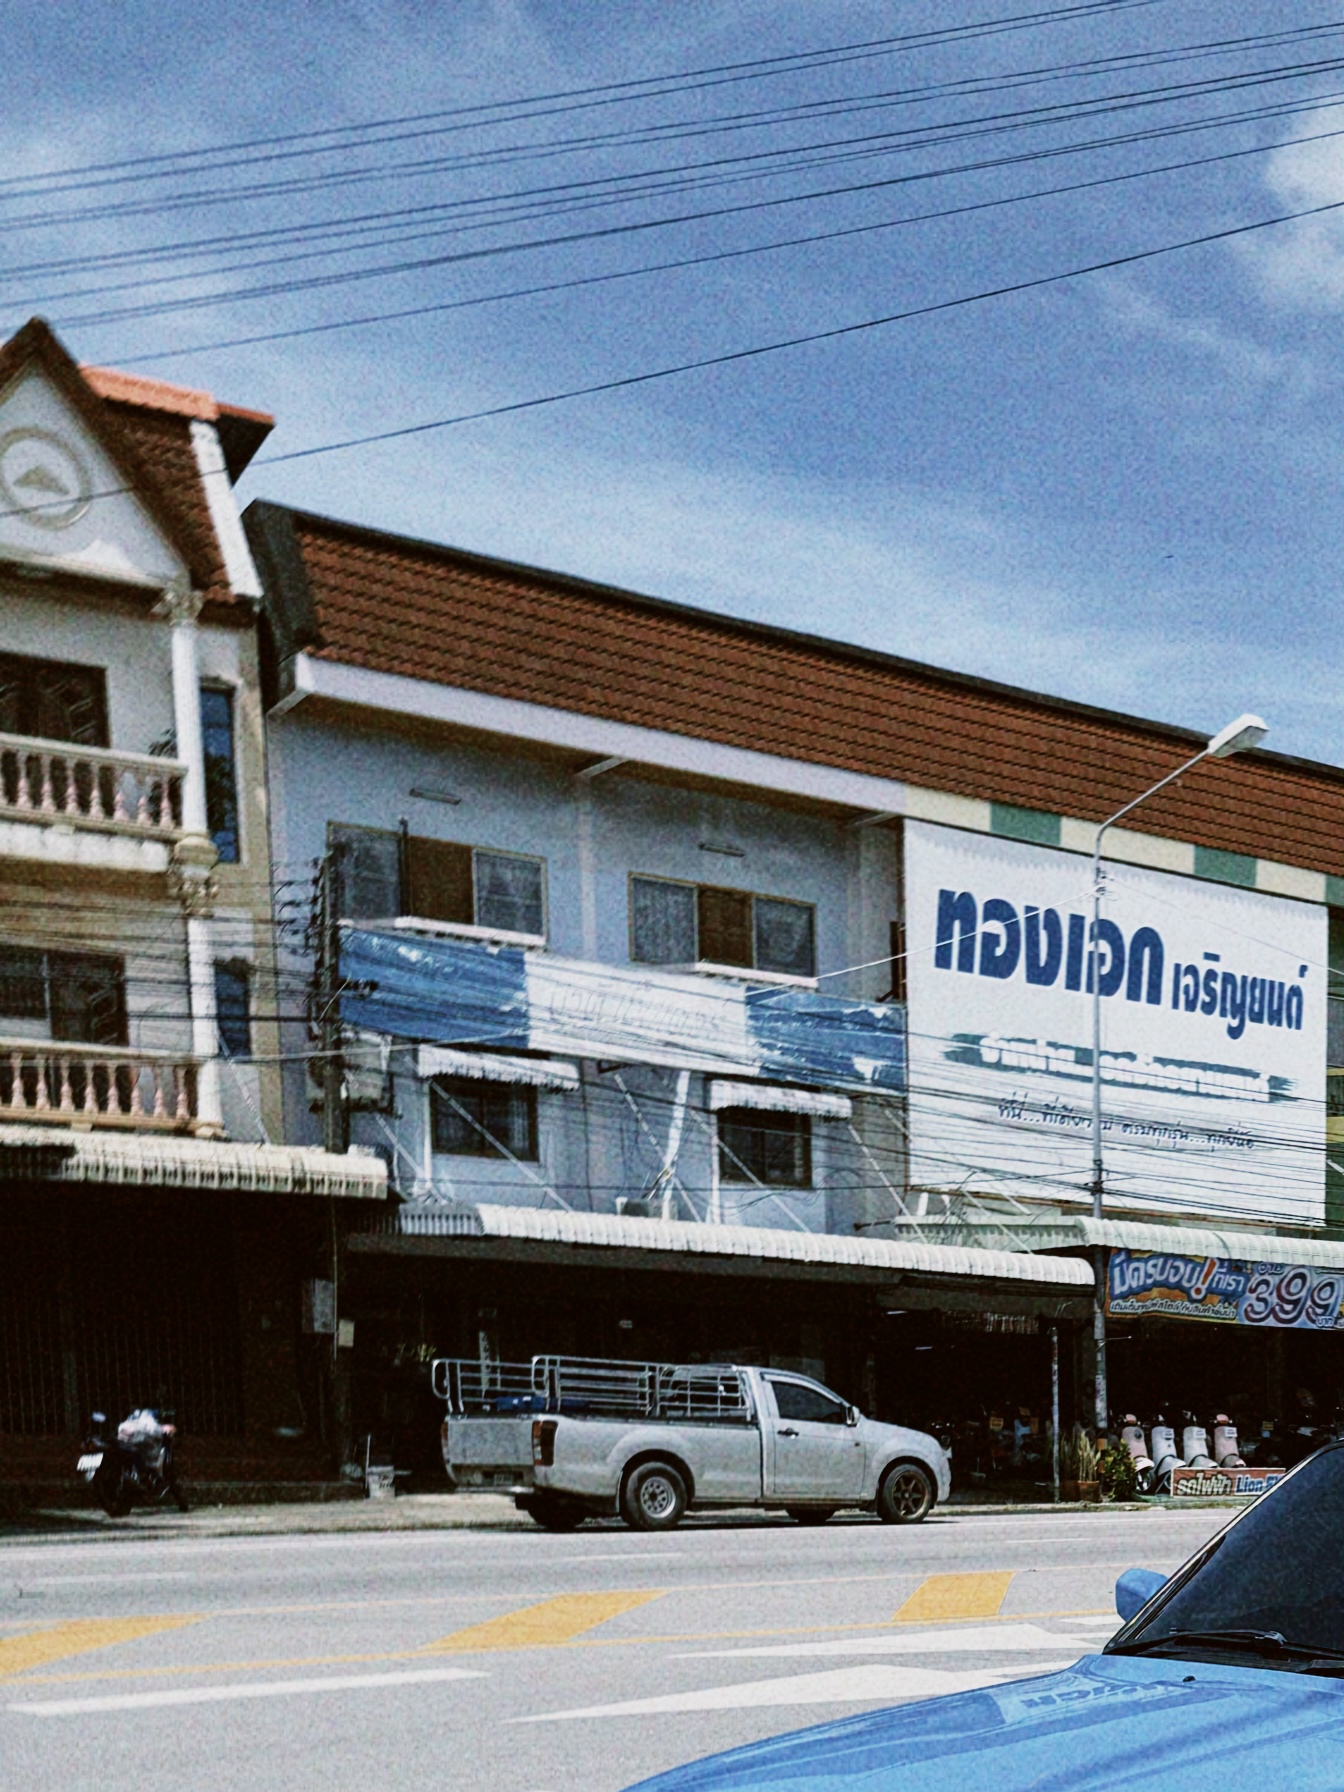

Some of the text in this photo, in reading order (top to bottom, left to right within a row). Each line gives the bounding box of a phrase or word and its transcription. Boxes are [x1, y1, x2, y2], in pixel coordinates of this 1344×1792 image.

[934, 888, 1309, 1040] ทองเอก เจริญยนต์
[1243, 1266, 1338, 1325] 399
[1177, 1472, 1232, 1496] รถไฟฟ้า
[1235, 1475, 1264, 1493] Lion
